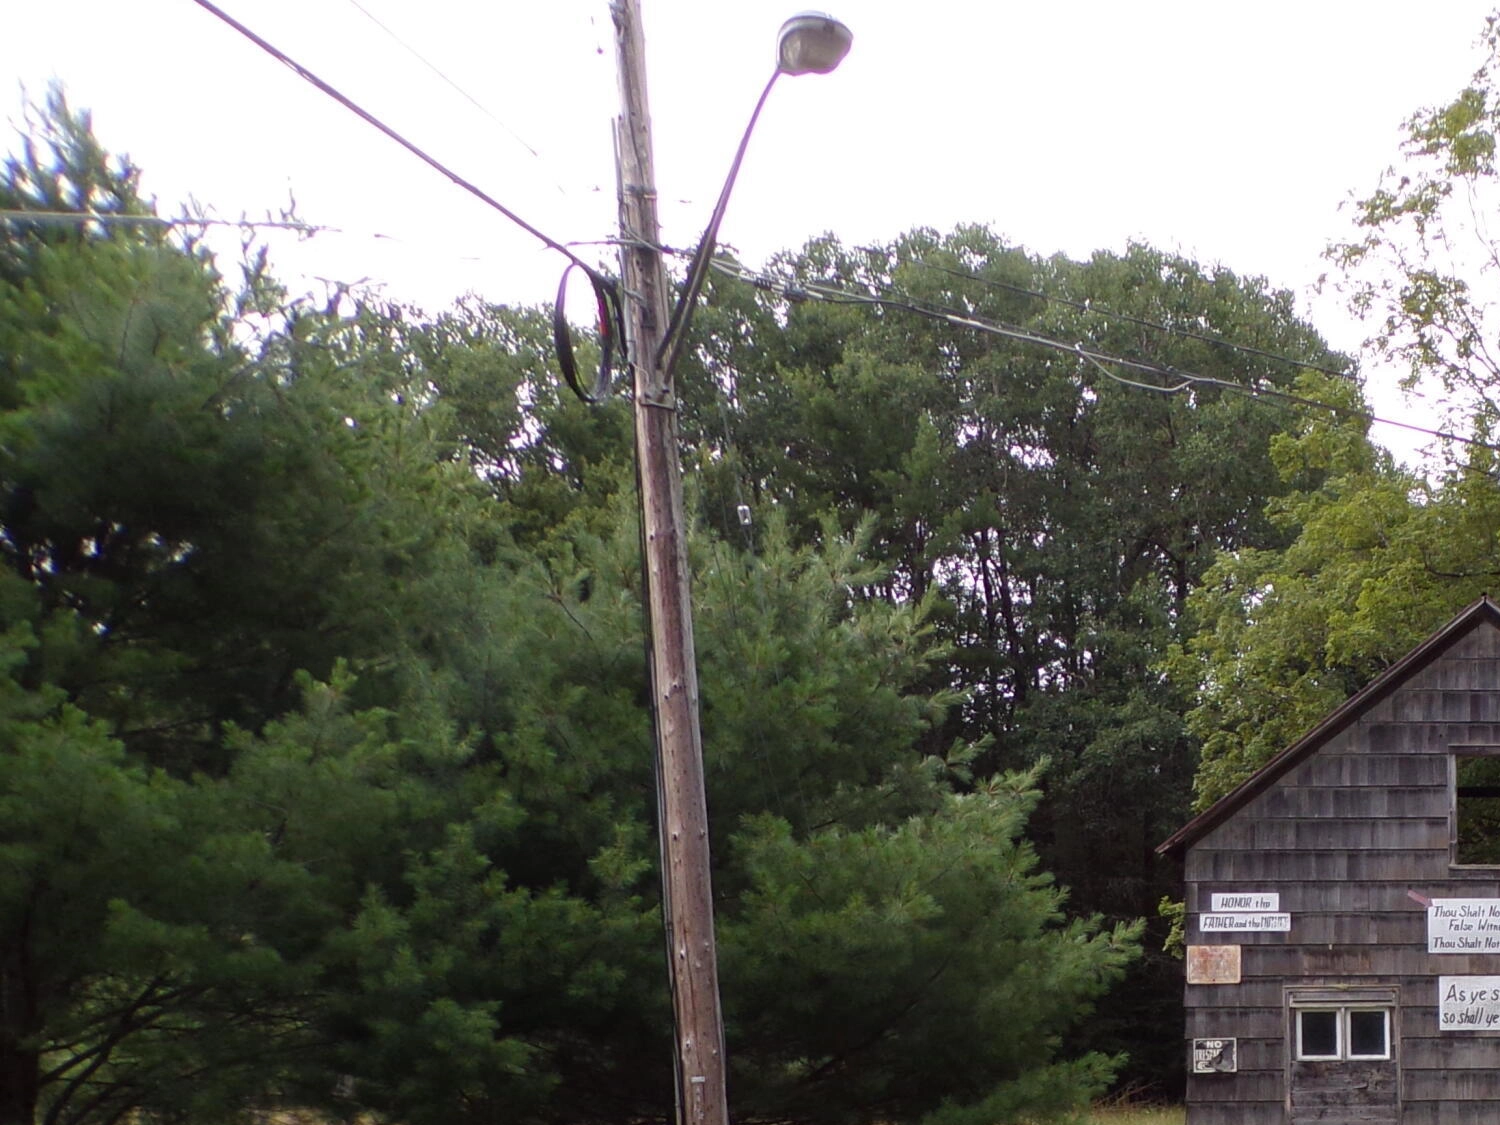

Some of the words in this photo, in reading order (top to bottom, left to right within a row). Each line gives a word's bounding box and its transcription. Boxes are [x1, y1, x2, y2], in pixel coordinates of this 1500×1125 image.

[1221, 897, 1252, 908] HONOR
[1434, 905, 1457, 918] Thou
[1459, 905, 1485, 918] Shalt
[1203, 916, 1235, 928] FATHER
[1449, 919, 1474, 931] False
[1433, 937, 1456, 949] Thou
[1457, 937, 1482, 949] Shalt
[1484, 937, 1500, 949] Not
[1444, 984, 1466, 1002] As
[1470, 990, 1487, 1005] ye
[1442, 1012, 1456, 1023] so
[1457, 1007, 1484, 1025] shall
[1486, 1013, 1500, 1027] ye
[1206, 1040, 1223, 1049] NO
